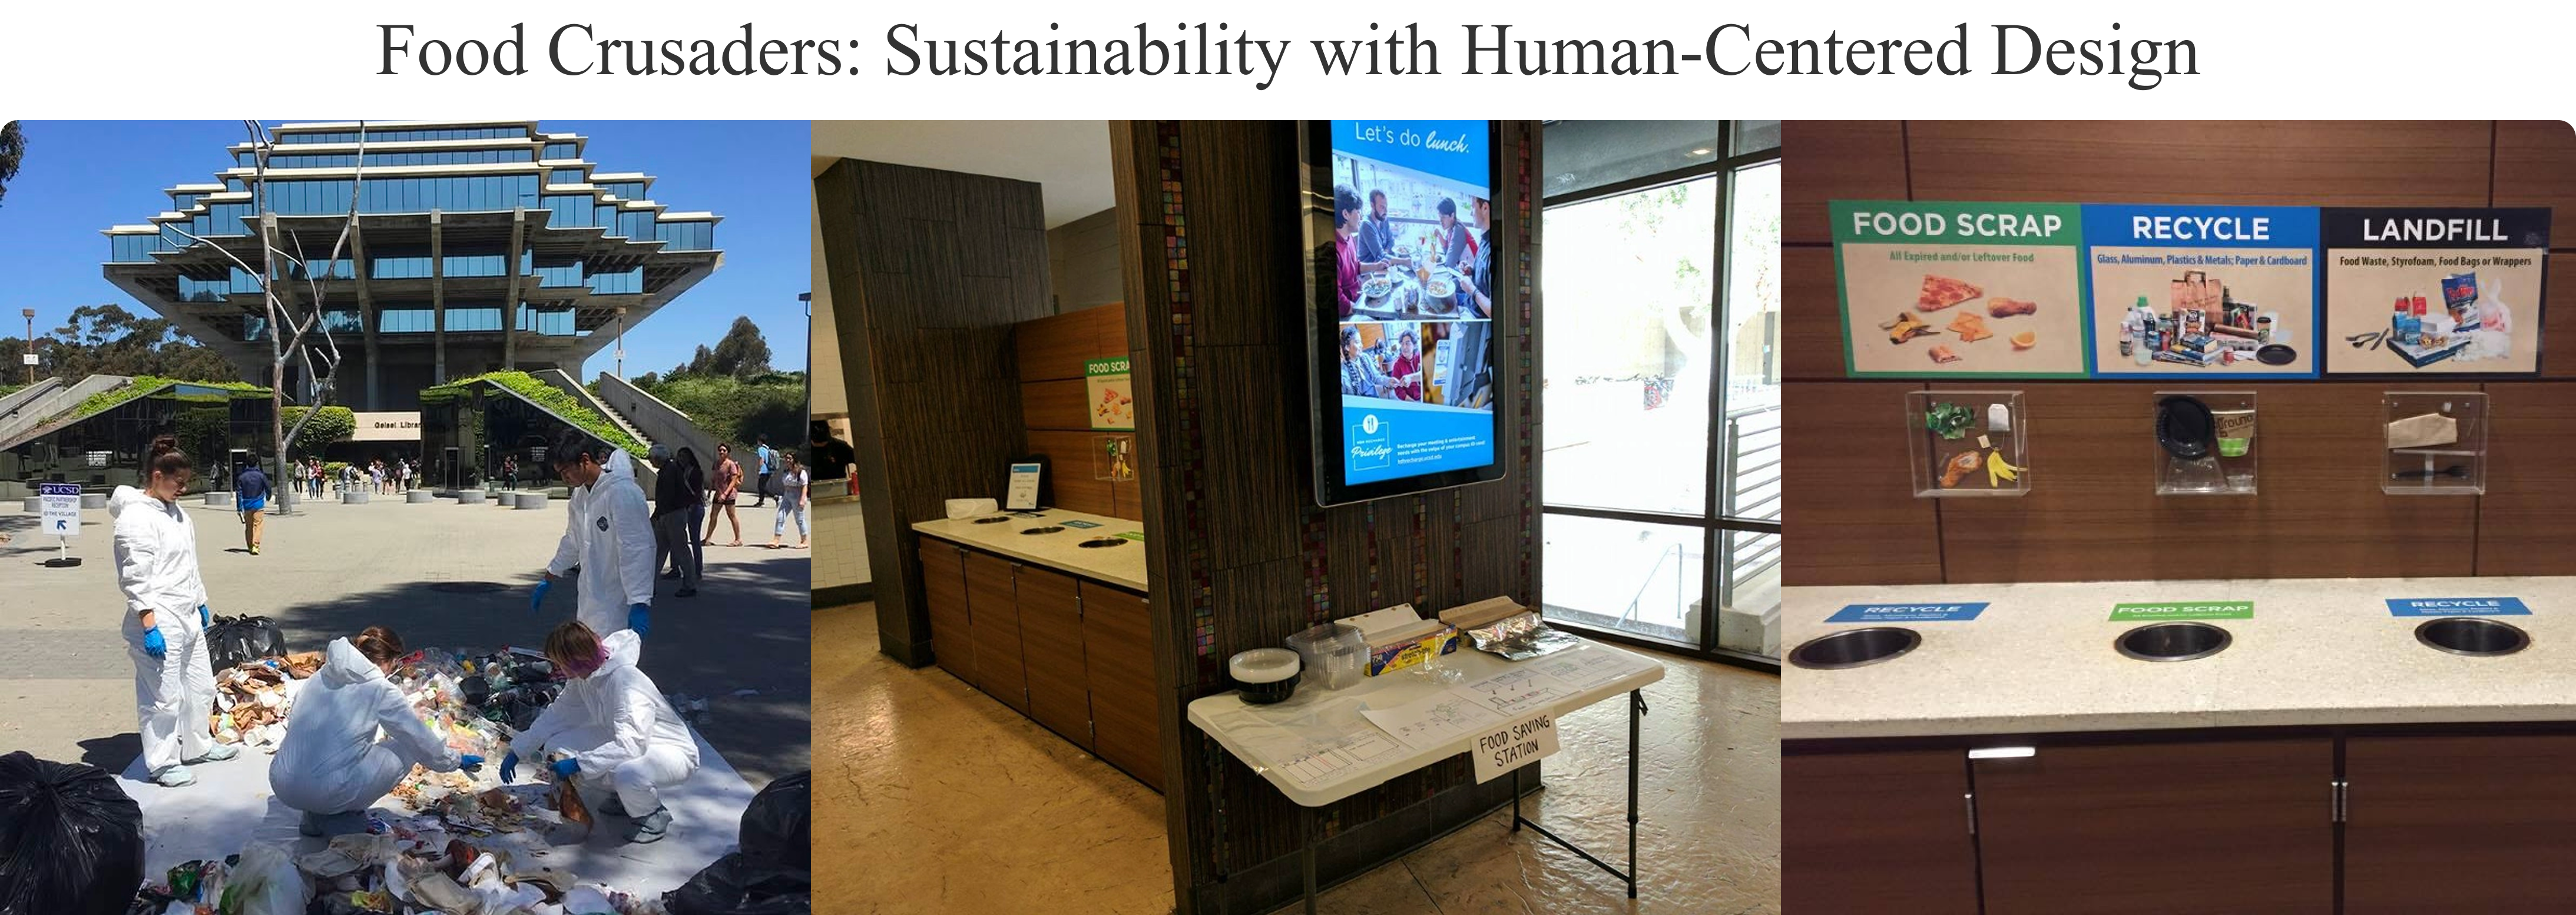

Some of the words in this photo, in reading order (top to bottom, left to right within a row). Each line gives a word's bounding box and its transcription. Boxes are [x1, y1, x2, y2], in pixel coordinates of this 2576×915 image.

[1356, 122, 1394, 144] Let's
[1400, 128, 1421, 147] do
[1426, 130, 1469, 153] lunch.
[1853, 213, 1946, 236] FOOD
[1957, 214, 2061, 237] SCRAP
[2133, 216, 2270, 240] RECYCLE
[2364, 219, 2508, 241] LANDFILL
[1890, 251, 1902, 260] All
[1904, 251, 1938, 263] Expired
[1940, 252, 1971, 262] and/or
[1973, 253, 2011, 262] Leftover
[2013, 253, 2034, 262] Food
[2098, 254, 2120, 265] Glass,
[2121, 254, 2166, 266] Aluminum,
[2167, 255, 2196, 264] Plastics
[2197, 255, 2204, 264] &
[2236, 256, 2258, 267] Paper
[2259, 256, 2266, 264] &
[2267, 256, 2307, 265] Cardboard
[2340, 256, 2359, 266] Food
[2362, 257, 2389, 267] Waste,
[2391, 257, 2437, 267] Styrofoam,
[2439, 257, 2459, 266] Food
[2461, 257, 2481, 268] Bags
[2492, 257, 2531, 267] Wrappers
[1089, 363, 1109, 373] FOOD
[1111, 360, 1130, 372] SCRA
[1351, 445, 1393, 460] Privilege
[1479, 731, 1508, 753] FOOD
[1513, 715, 1549, 740] SAVING
[1495, 738, 1538, 767] STATION
